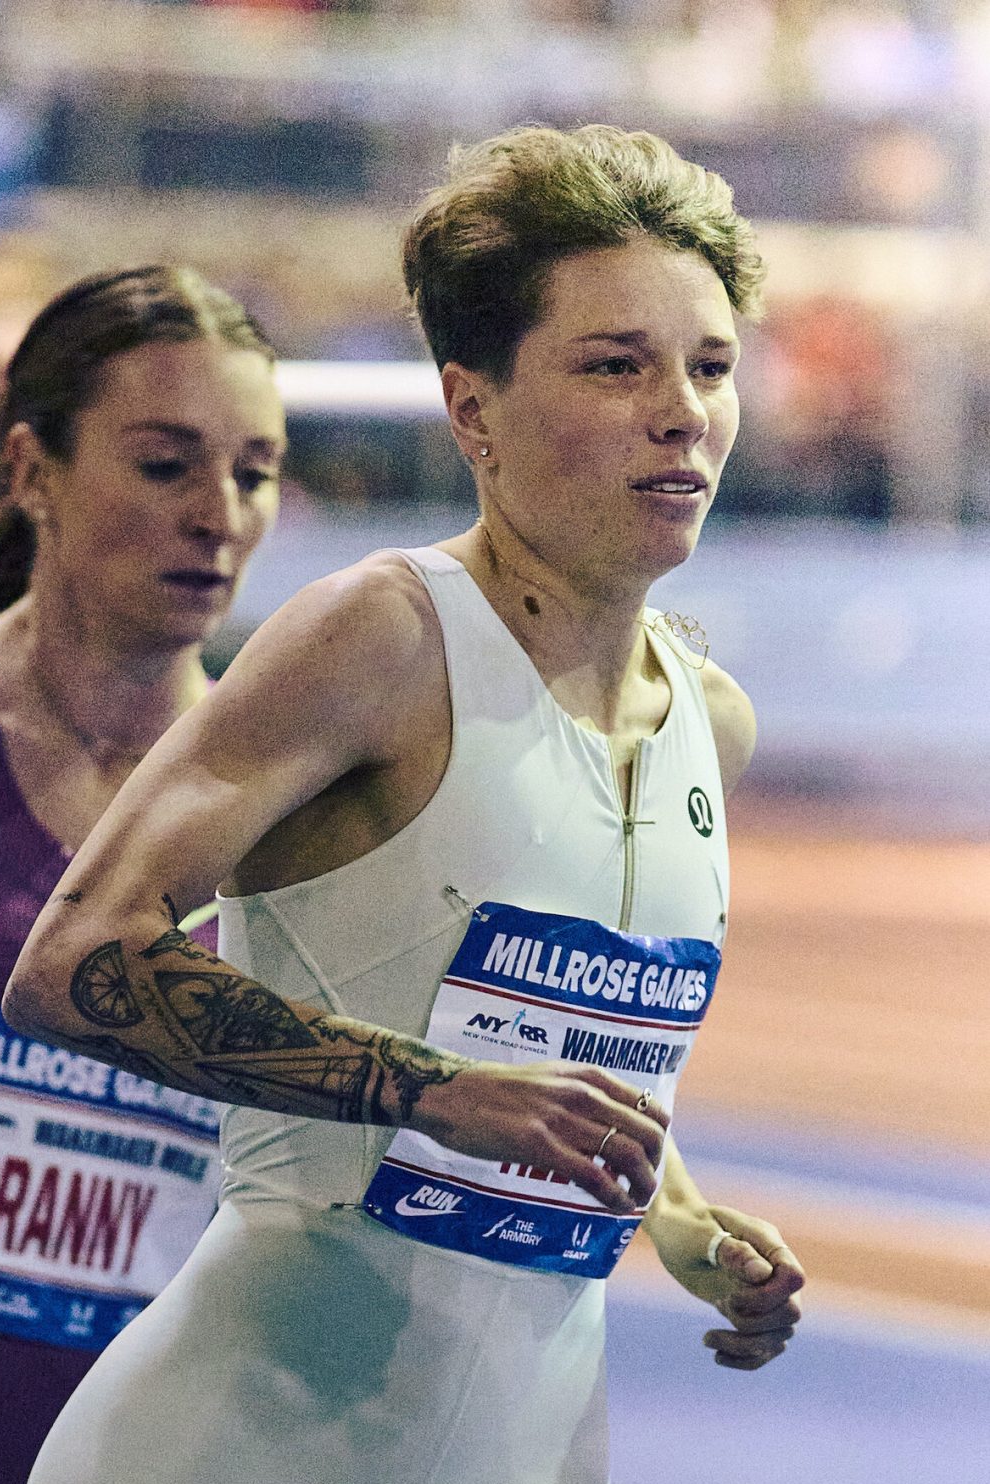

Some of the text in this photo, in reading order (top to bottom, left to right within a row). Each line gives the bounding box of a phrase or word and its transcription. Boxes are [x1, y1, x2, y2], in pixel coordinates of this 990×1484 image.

[482, 933, 707, 1012] MILLROSE GAMES
[462, 1030, 548, 1056] NEW YORK ROAD RUNNERS
[560, 1027, 670, 1075] WANAMAKER
[412, 1184, 463, 1211] RUN
[498, 1230, 543, 1246] ARMORY
[515, 1219, 536, 1233] THE
